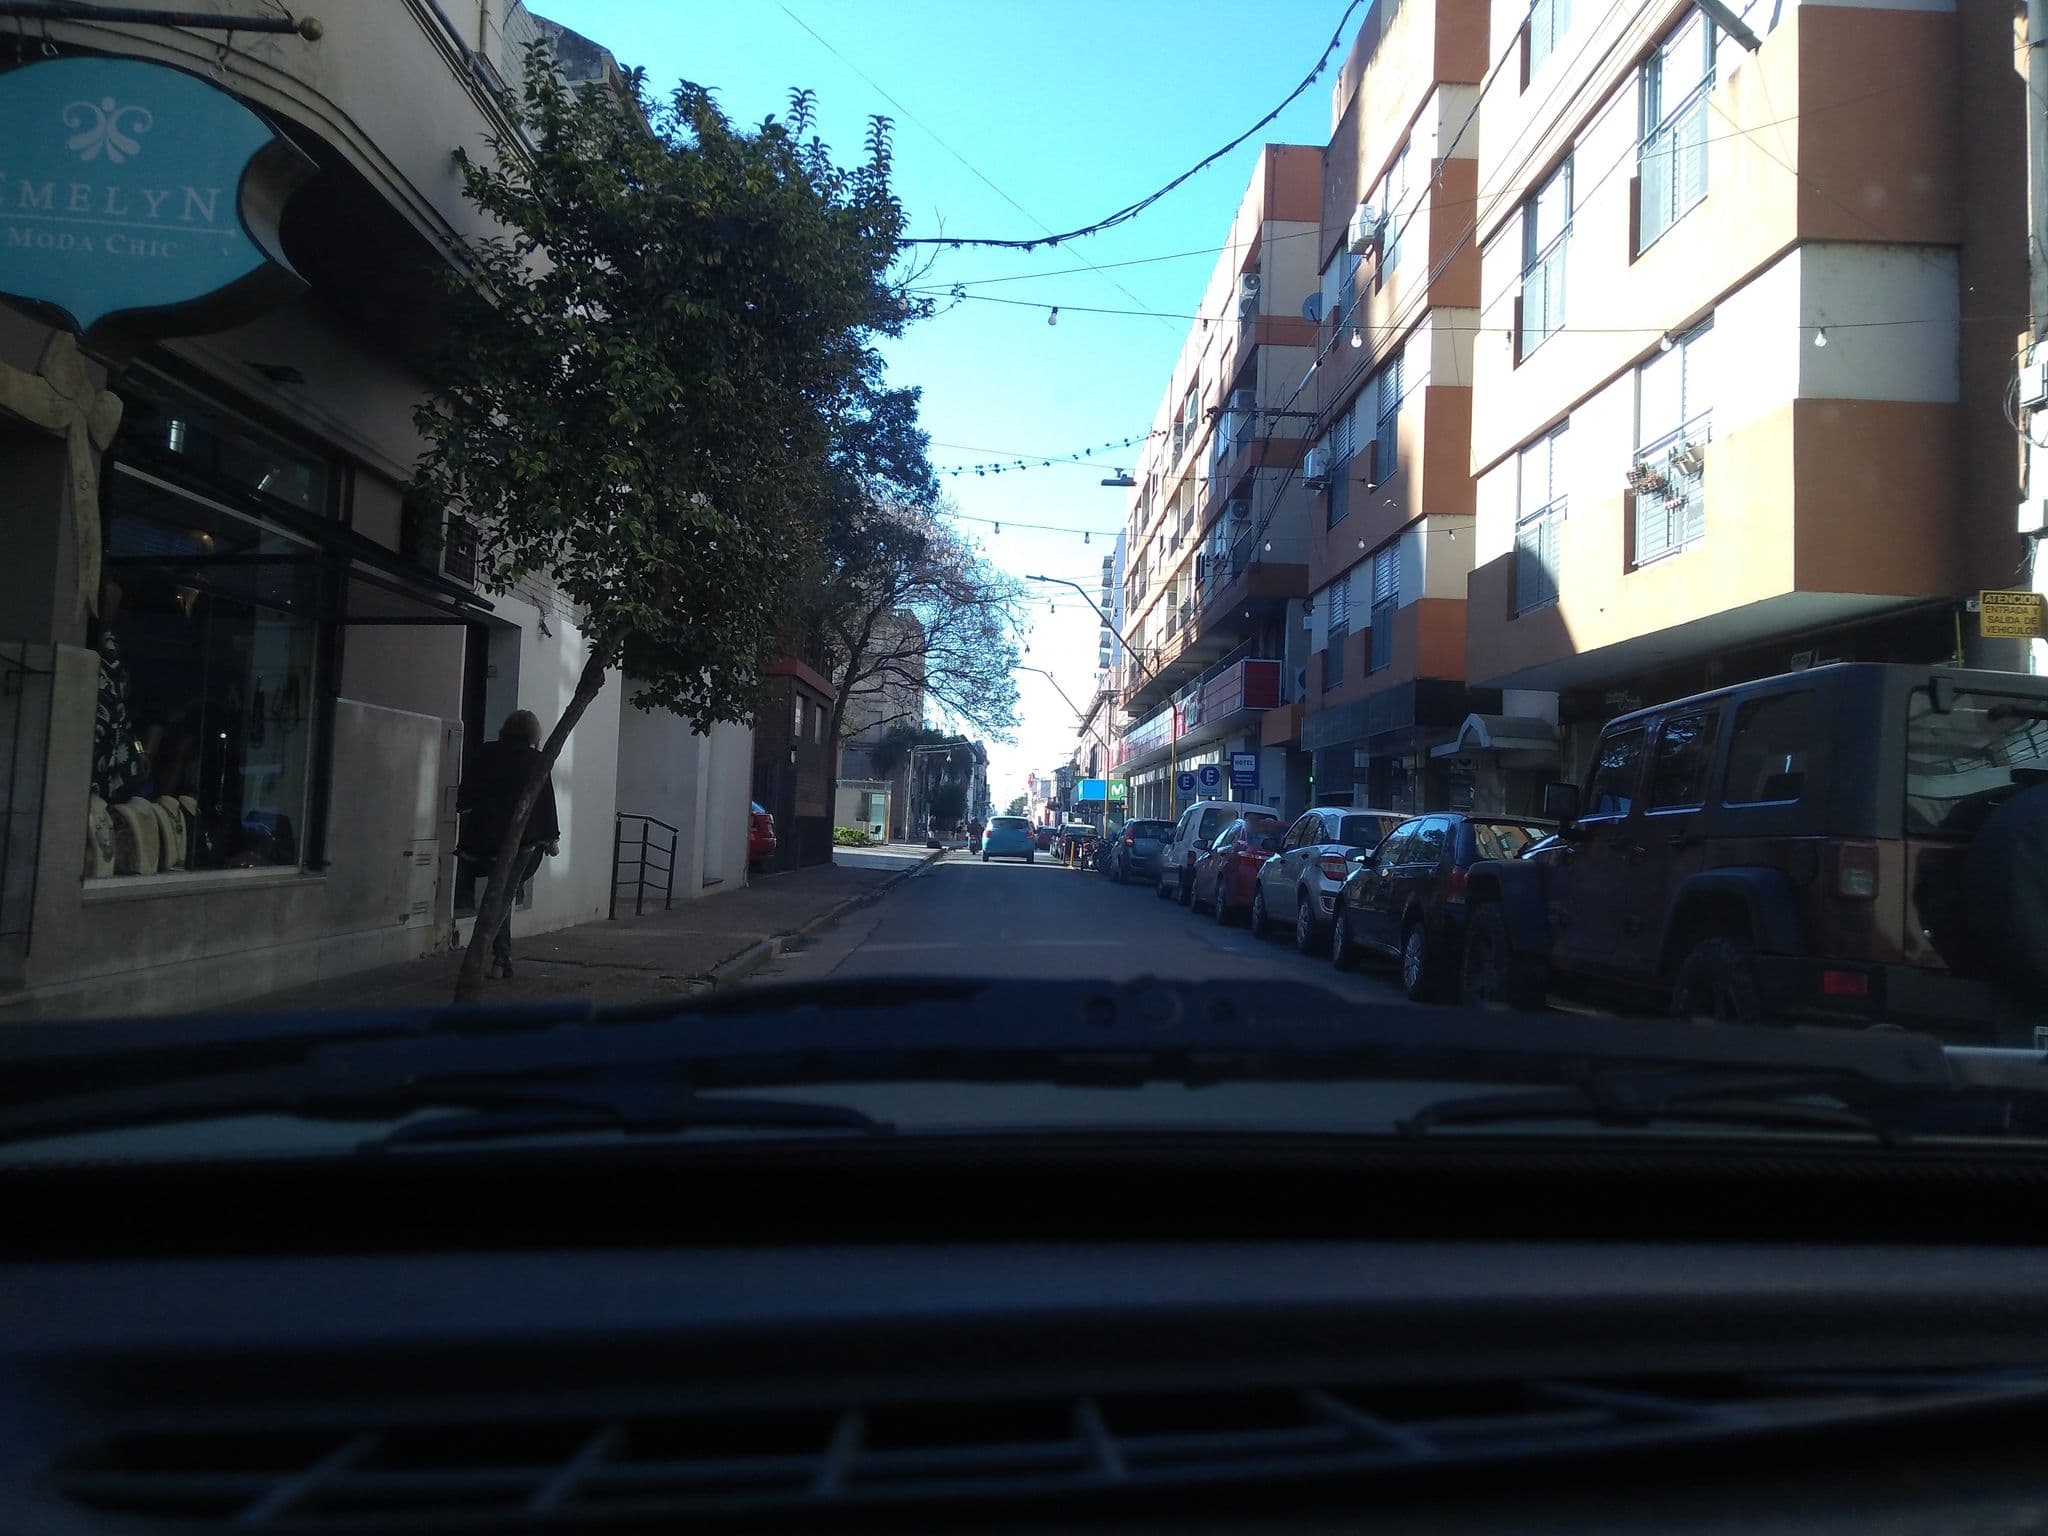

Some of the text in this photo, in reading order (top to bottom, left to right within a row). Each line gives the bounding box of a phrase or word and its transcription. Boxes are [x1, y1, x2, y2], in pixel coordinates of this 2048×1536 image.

[0, 172, 221, 223] MELYN
[1985, 594, 2040, 605] ATENCION
[1985, 606, 2028, 615] ENTRADA
[1987, 616, 2038, 625] SALIDA DE
[1183, 776, 1190, 788] E
[1206, 770, 1214, 783] E
